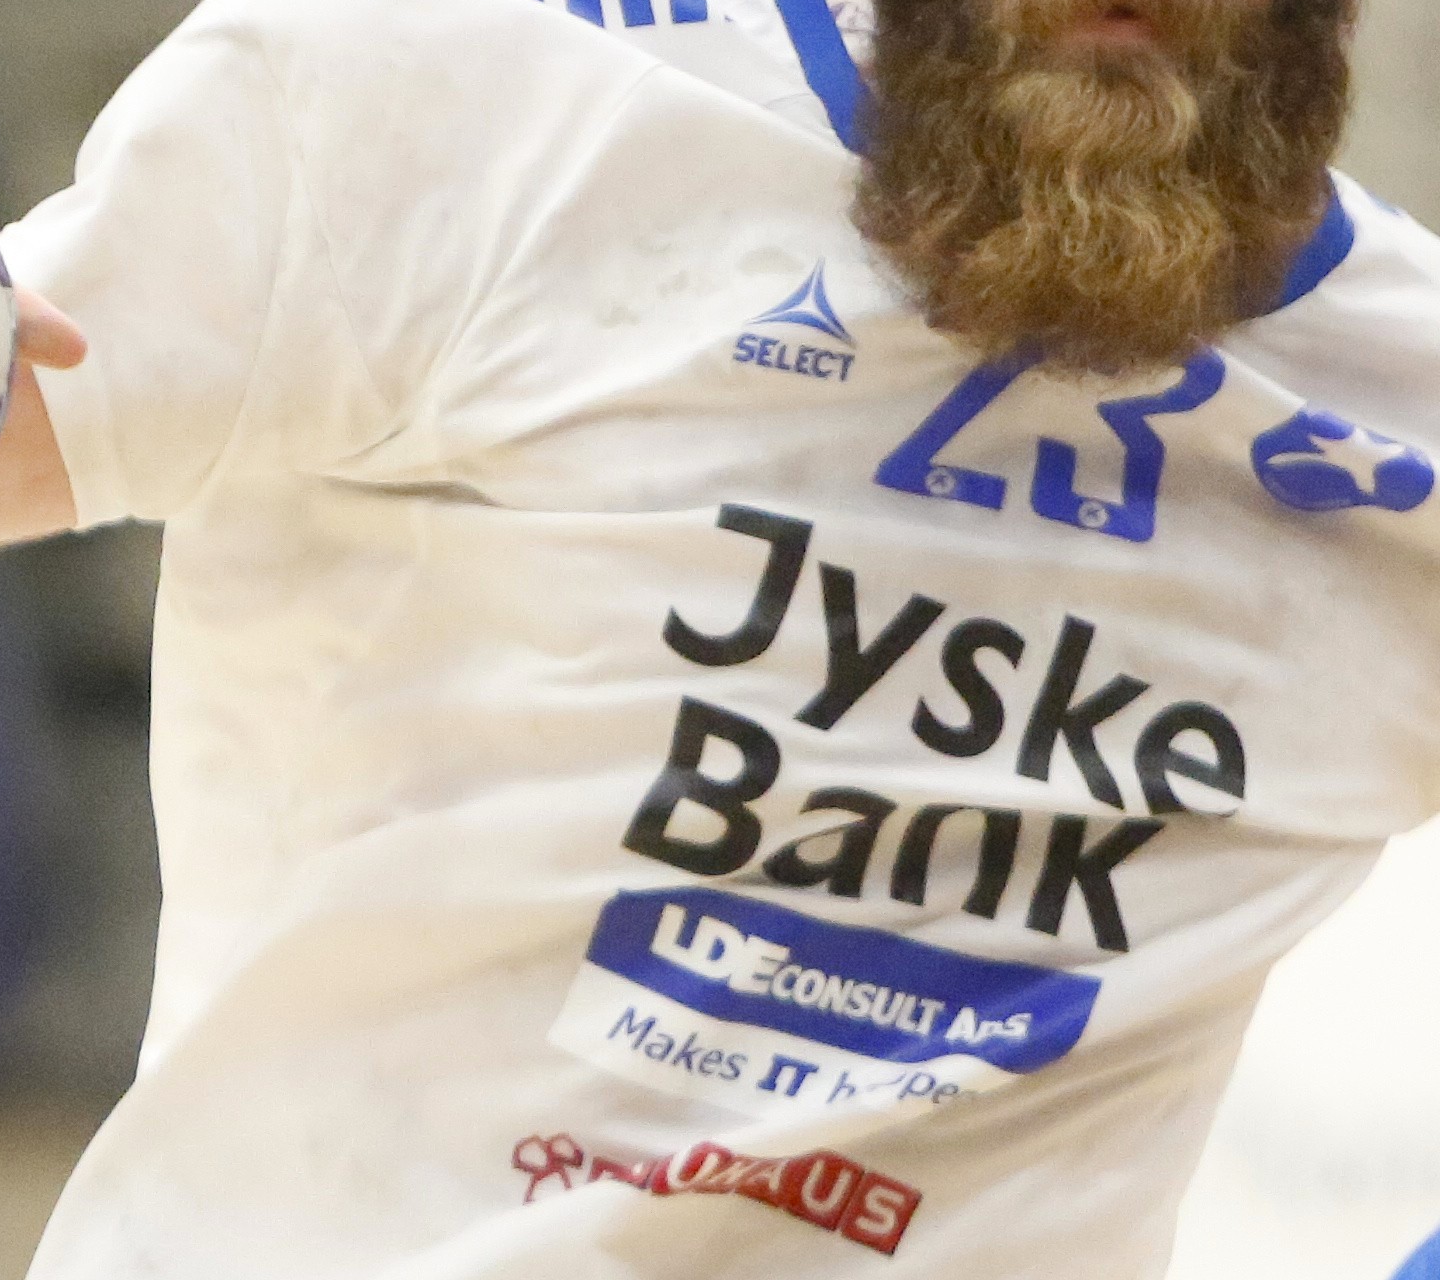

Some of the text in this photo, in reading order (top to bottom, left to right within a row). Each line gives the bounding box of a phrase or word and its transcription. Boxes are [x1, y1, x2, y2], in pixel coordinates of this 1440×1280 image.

[733, 333, 855, 381] SELECT
[663, 502, 1245, 817] Jyske
[621, 695, 1166, 953] Bank
[607, 1006, 748, 1081] Makes
[757, 1053, 819, 1098] IT
